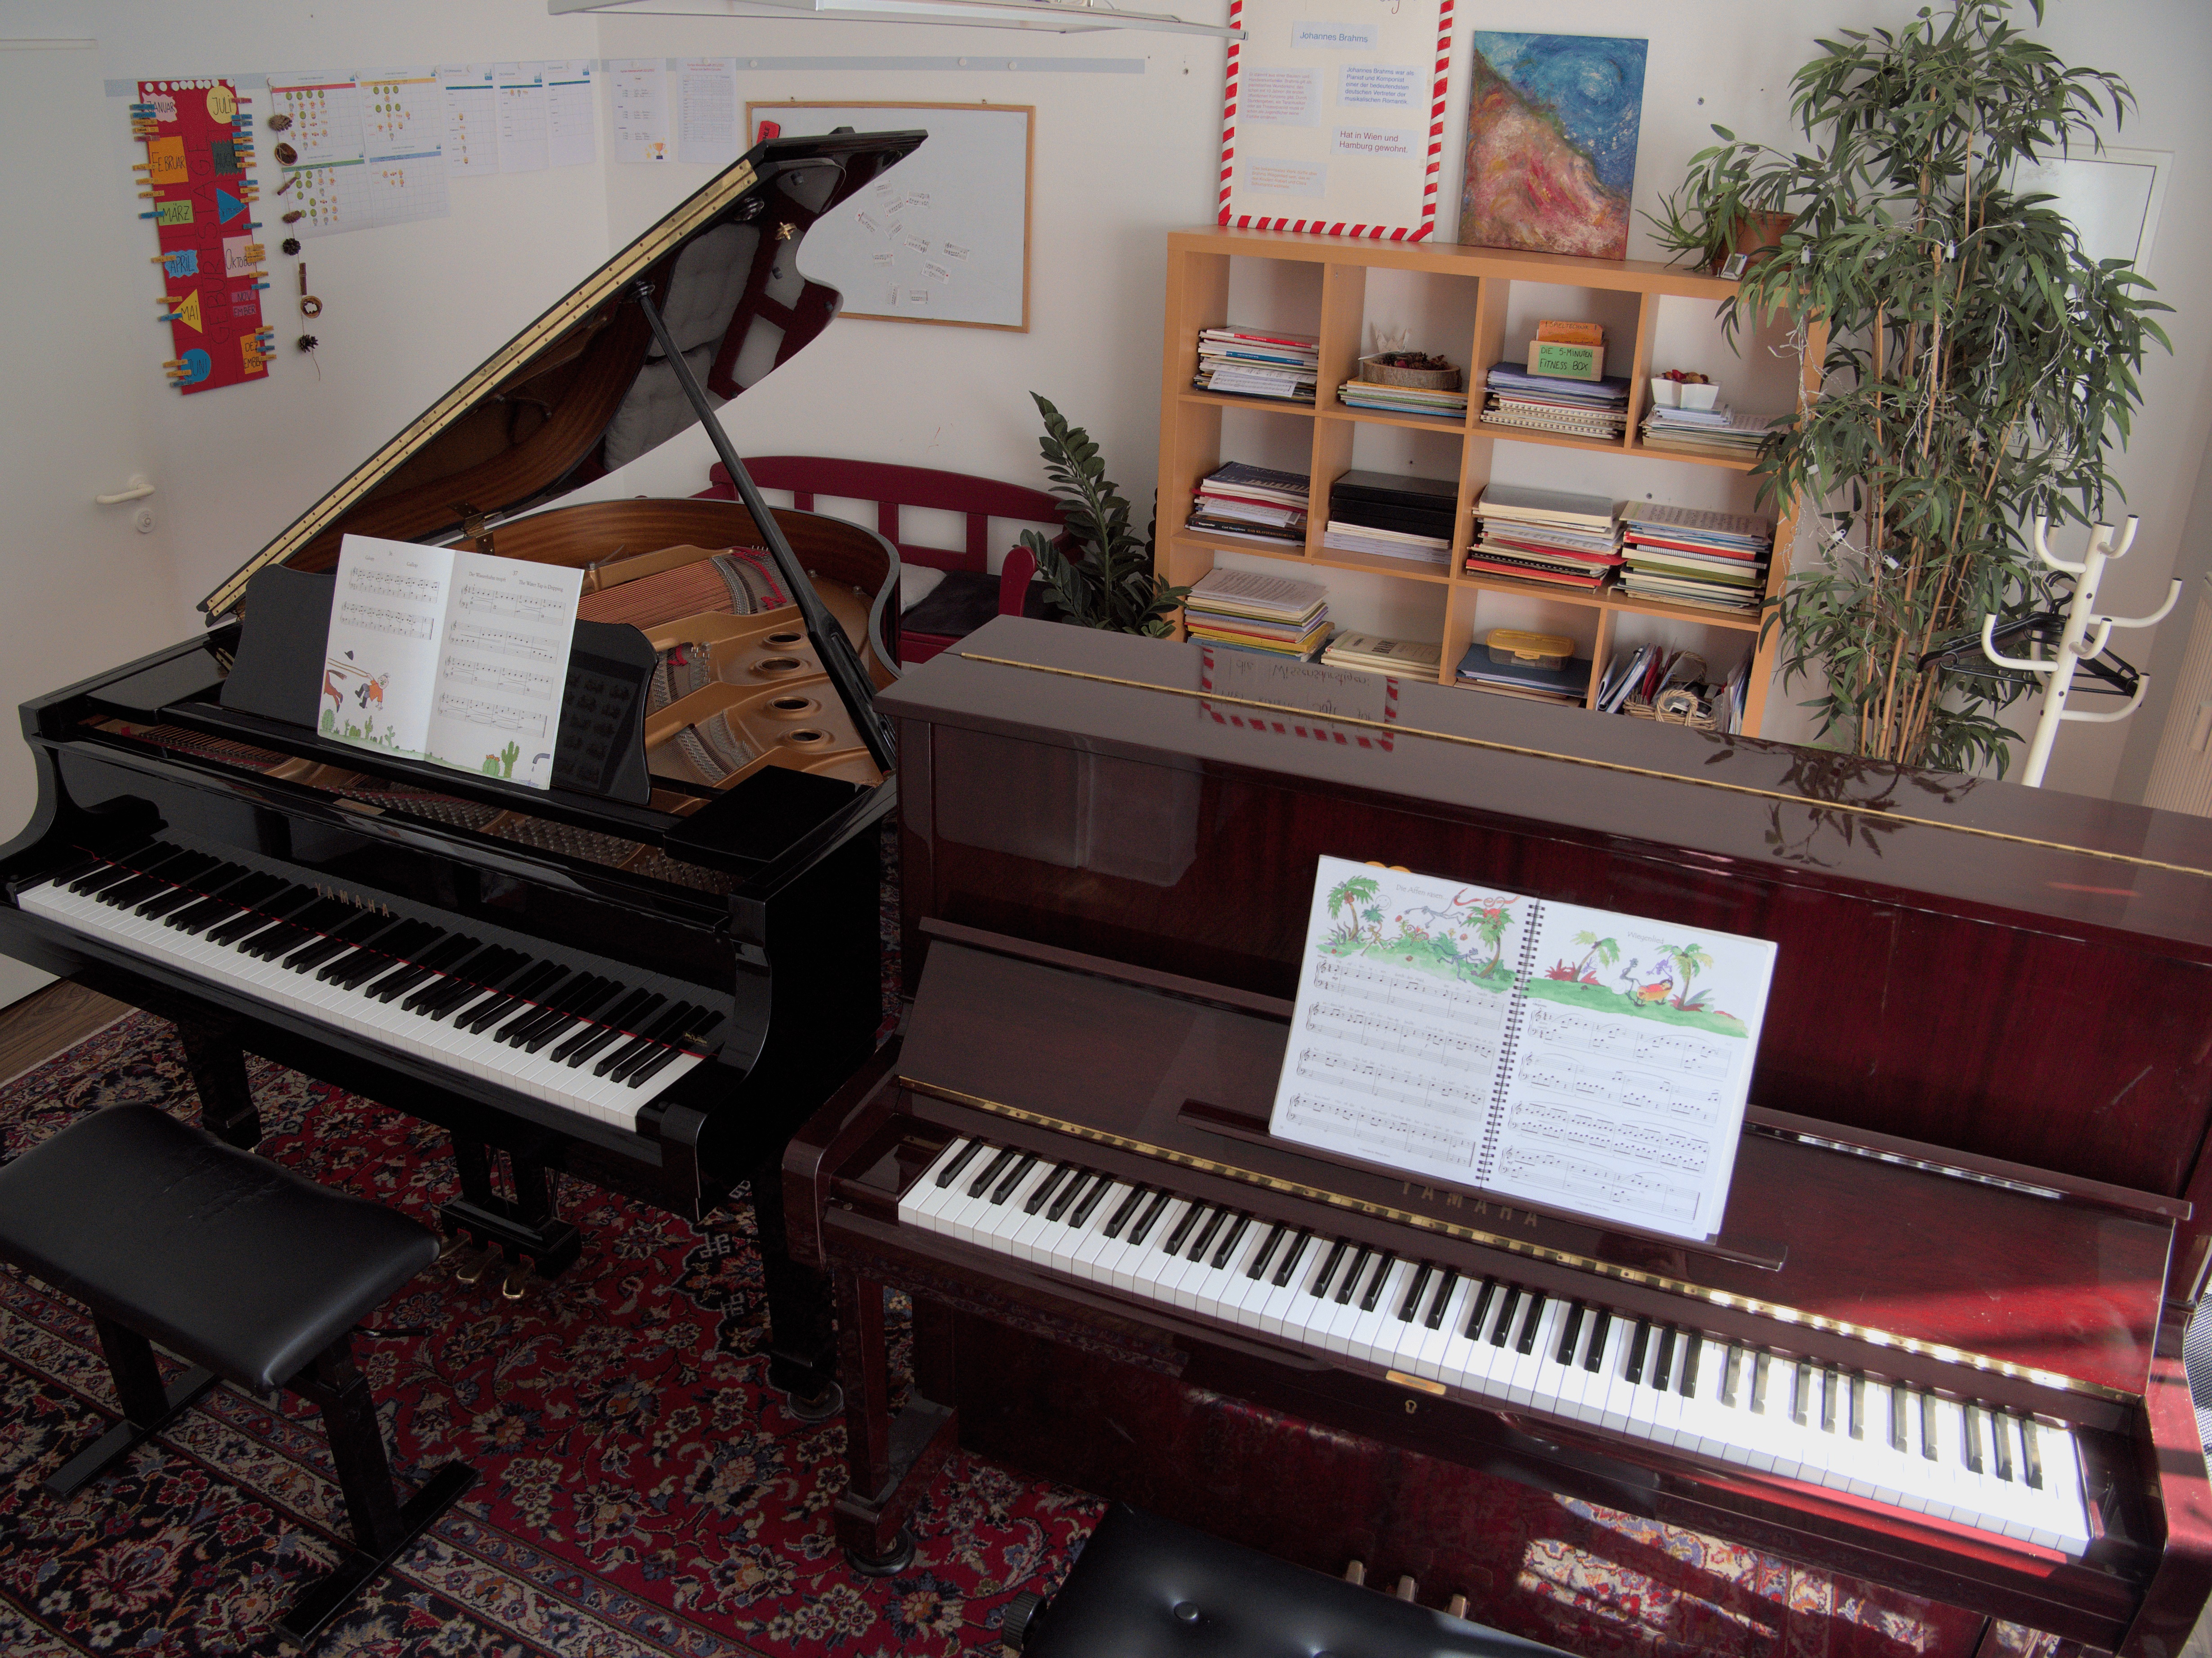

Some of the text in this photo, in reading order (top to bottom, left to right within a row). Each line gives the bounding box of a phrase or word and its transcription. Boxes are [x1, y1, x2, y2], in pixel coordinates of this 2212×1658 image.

[1300, 32, 1368, 42] Johannes Brahms
[147, 101, 175, 113] JANUAR
[1339, 141, 1408, 153] Hamburg gewohnt.
[162, 203, 190, 222] MÄRZ
[185, 135, 230, 344] GEBURTSTAGE
[237, 292, 253, 302] NOV
[233, 305, 255, 317] EMBER
[245, 341, 258, 352] DEZ
[1572, 361, 1588, 371] BOX
[1236, 464, 1310, 480] PIANORA
[1256, 529, 1294, 538] KLAVIERHANDBUCH
[1407, 886, 1425, 895] Affen
[314, 882, 390, 918] YAMAHA
[1628, 931, 1664, 944] Wiegenlied
